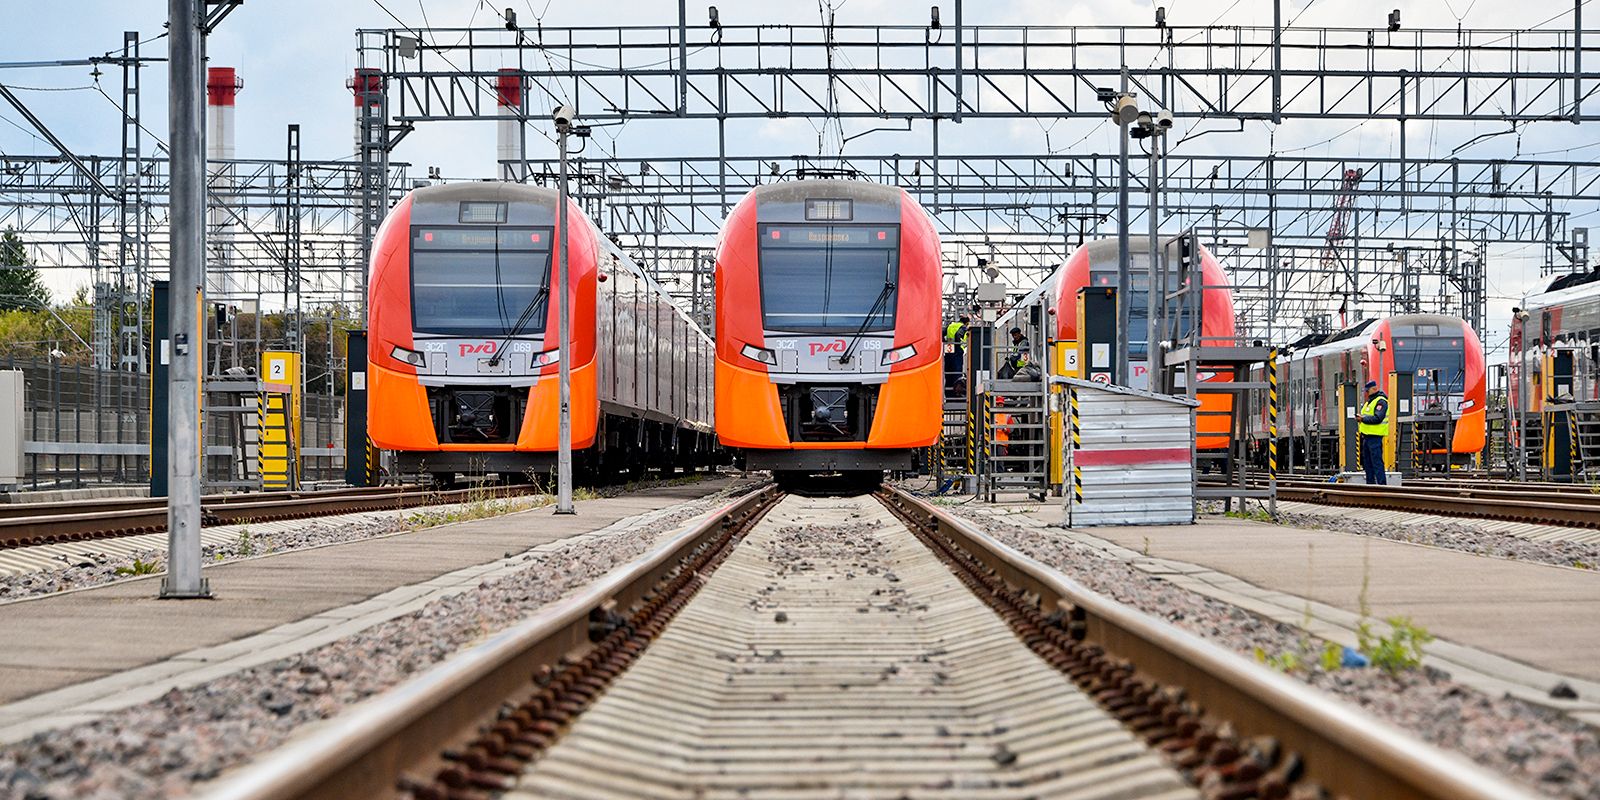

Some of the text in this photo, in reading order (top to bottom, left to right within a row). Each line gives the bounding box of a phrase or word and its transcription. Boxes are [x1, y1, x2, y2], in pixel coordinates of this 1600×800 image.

[946, 343, 953, 353] 3
[1023, 352, 1029, 361] 3
[1069, 355, 1076, 365] 5
[274, 364, 281, 374] 2
